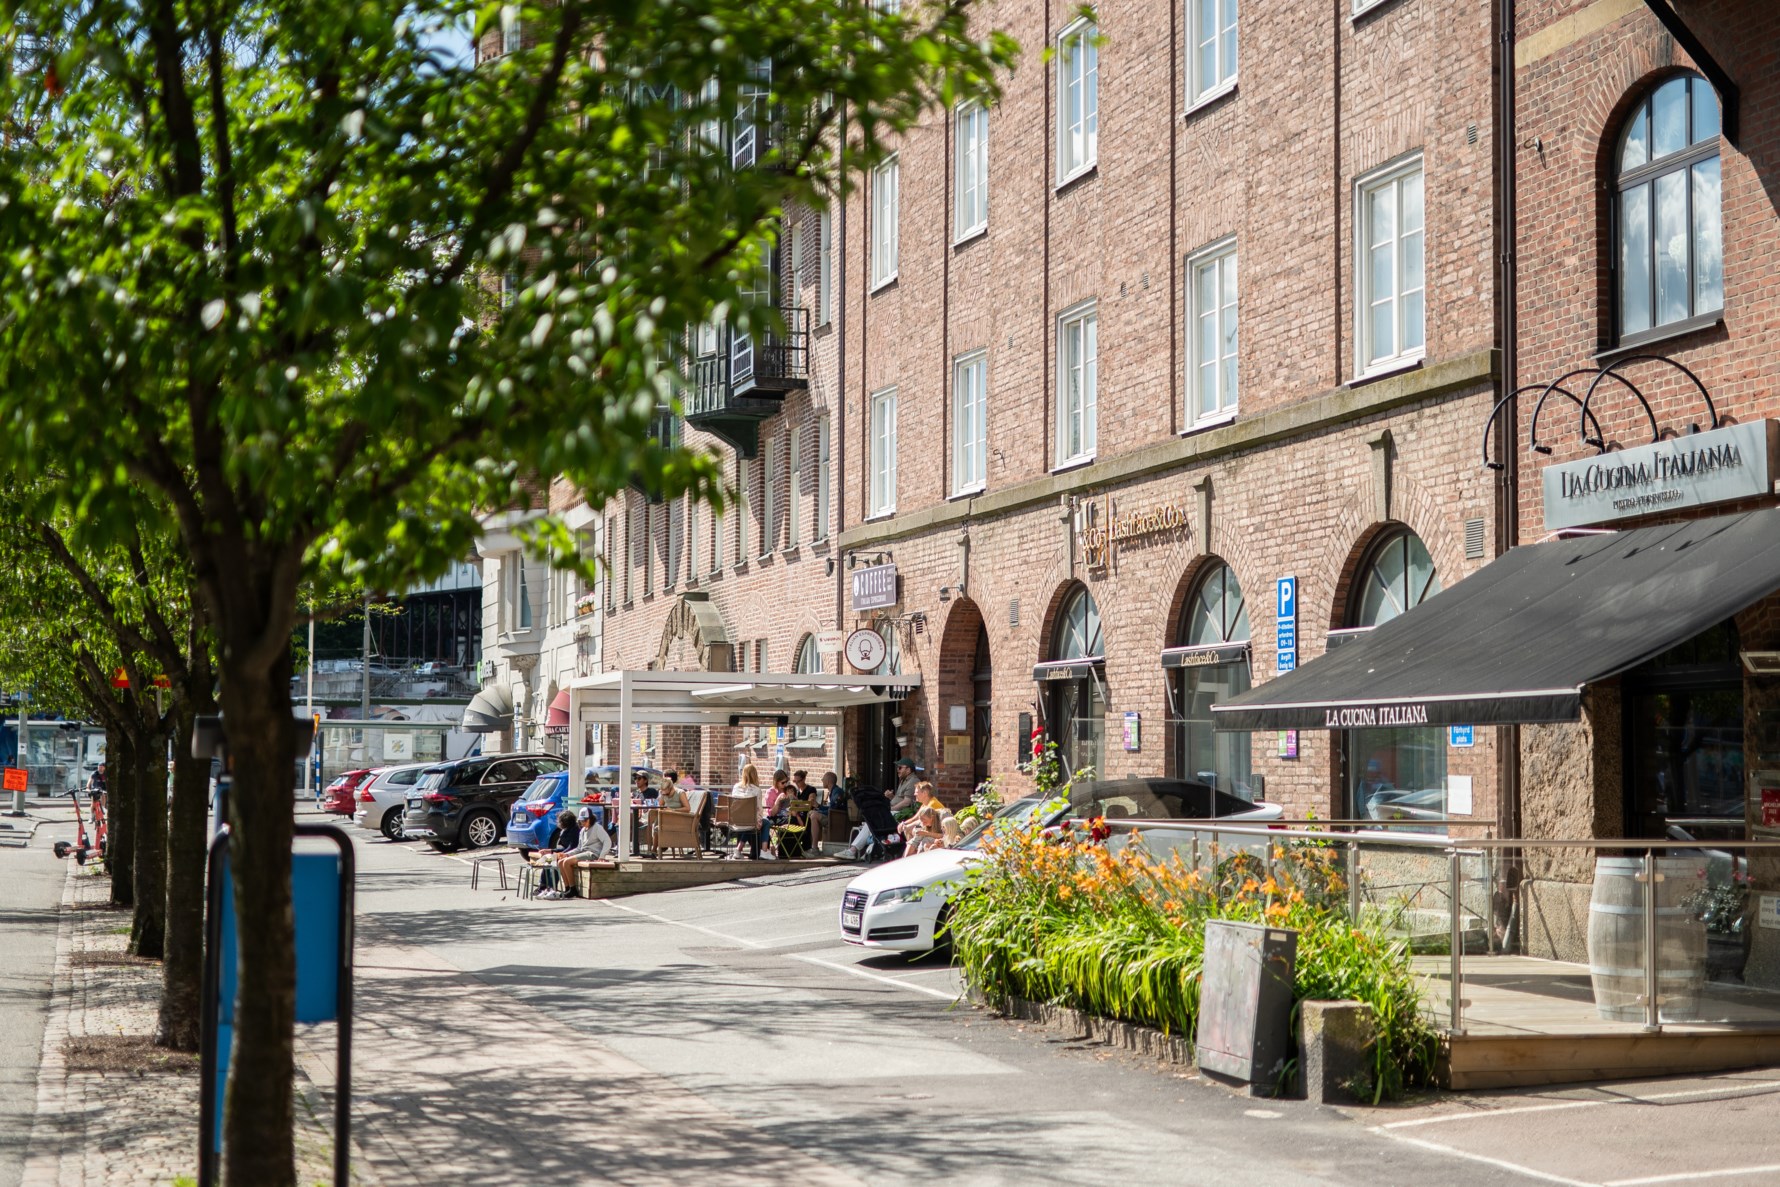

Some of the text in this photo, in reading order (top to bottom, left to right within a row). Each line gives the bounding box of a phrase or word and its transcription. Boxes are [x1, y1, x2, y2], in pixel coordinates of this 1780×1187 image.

[861, 570, 886, 596] COFFEE
[1281, 581, 1292, 615] P
[1326, 704, 1428, 727] LA CUCINA ITALIANA
